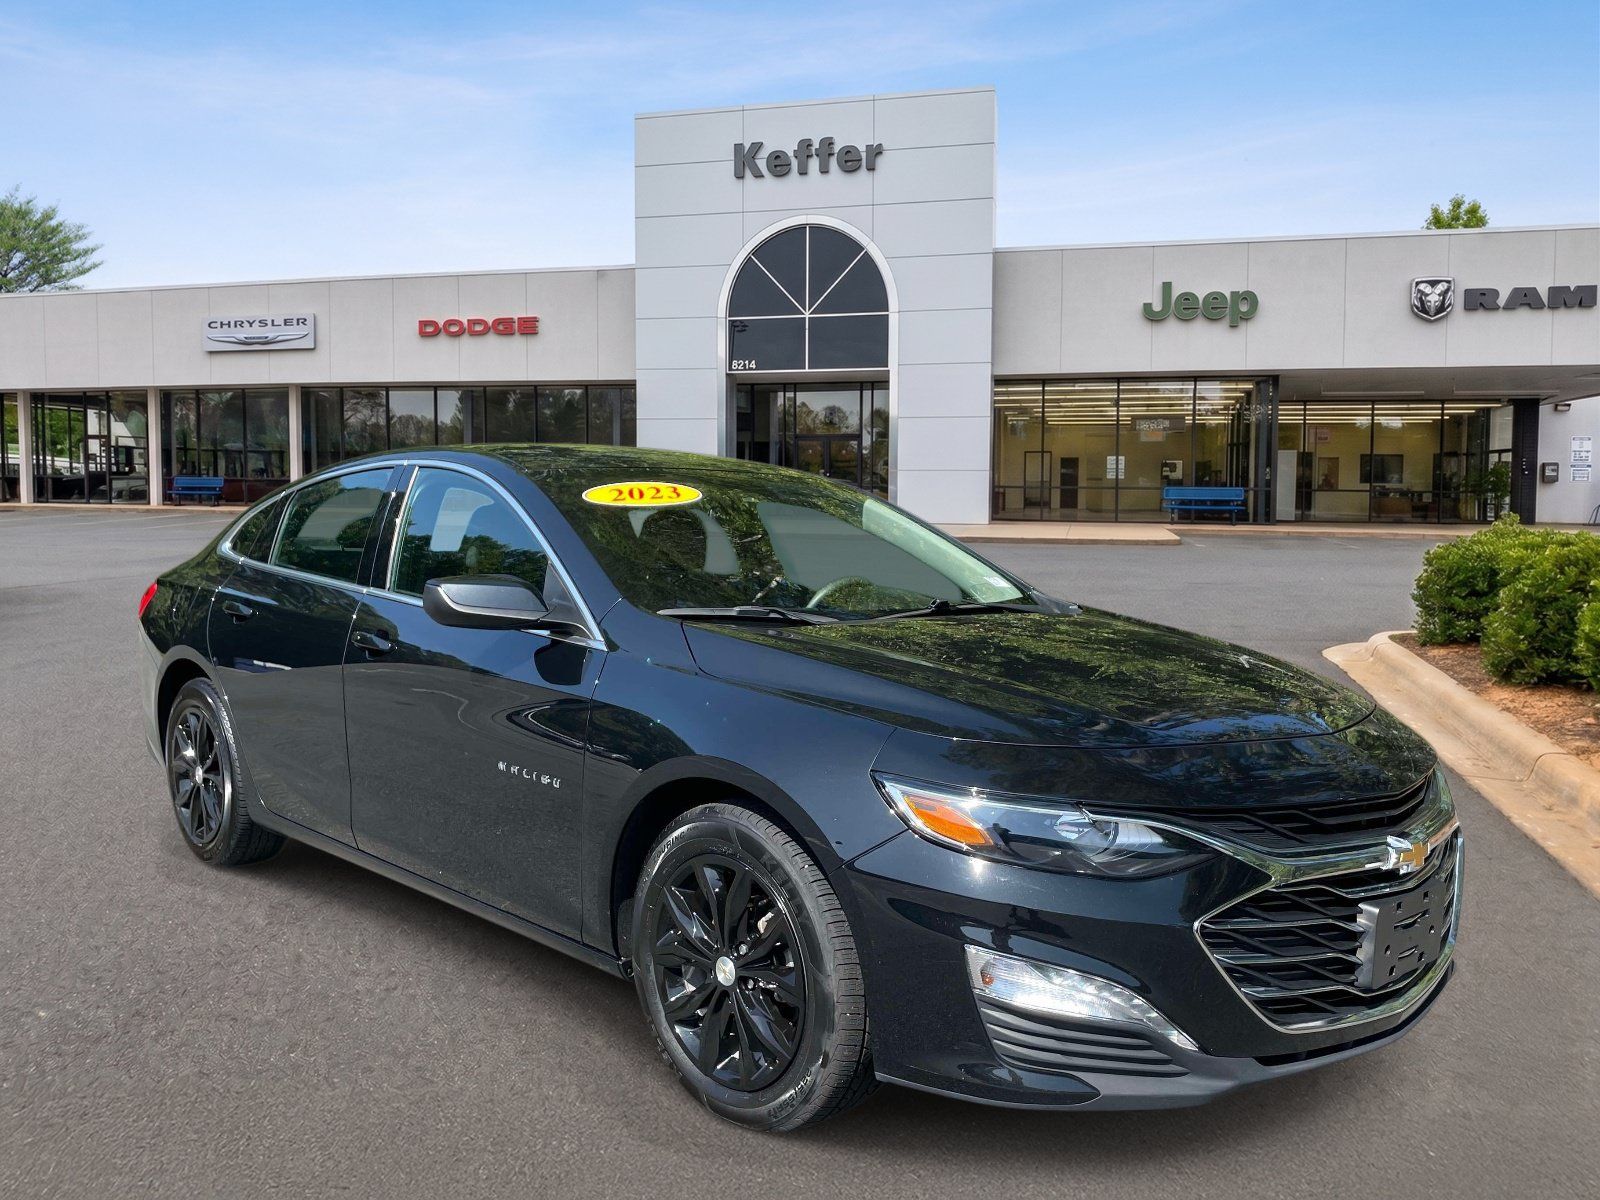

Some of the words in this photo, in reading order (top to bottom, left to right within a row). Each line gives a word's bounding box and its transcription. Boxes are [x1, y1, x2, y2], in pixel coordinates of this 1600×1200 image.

[733, 136, 884, 179] Keffer
[1143, 281, 1259, 327] Jeep
[1464, 284, 1598, 310] RAM
[207, 317, 308, 330] CHRYSLER
[418, 316, 539, 337] DODGE
[731, 360, 757, 370] 8214
[609, 486, 681, 502] 2023
